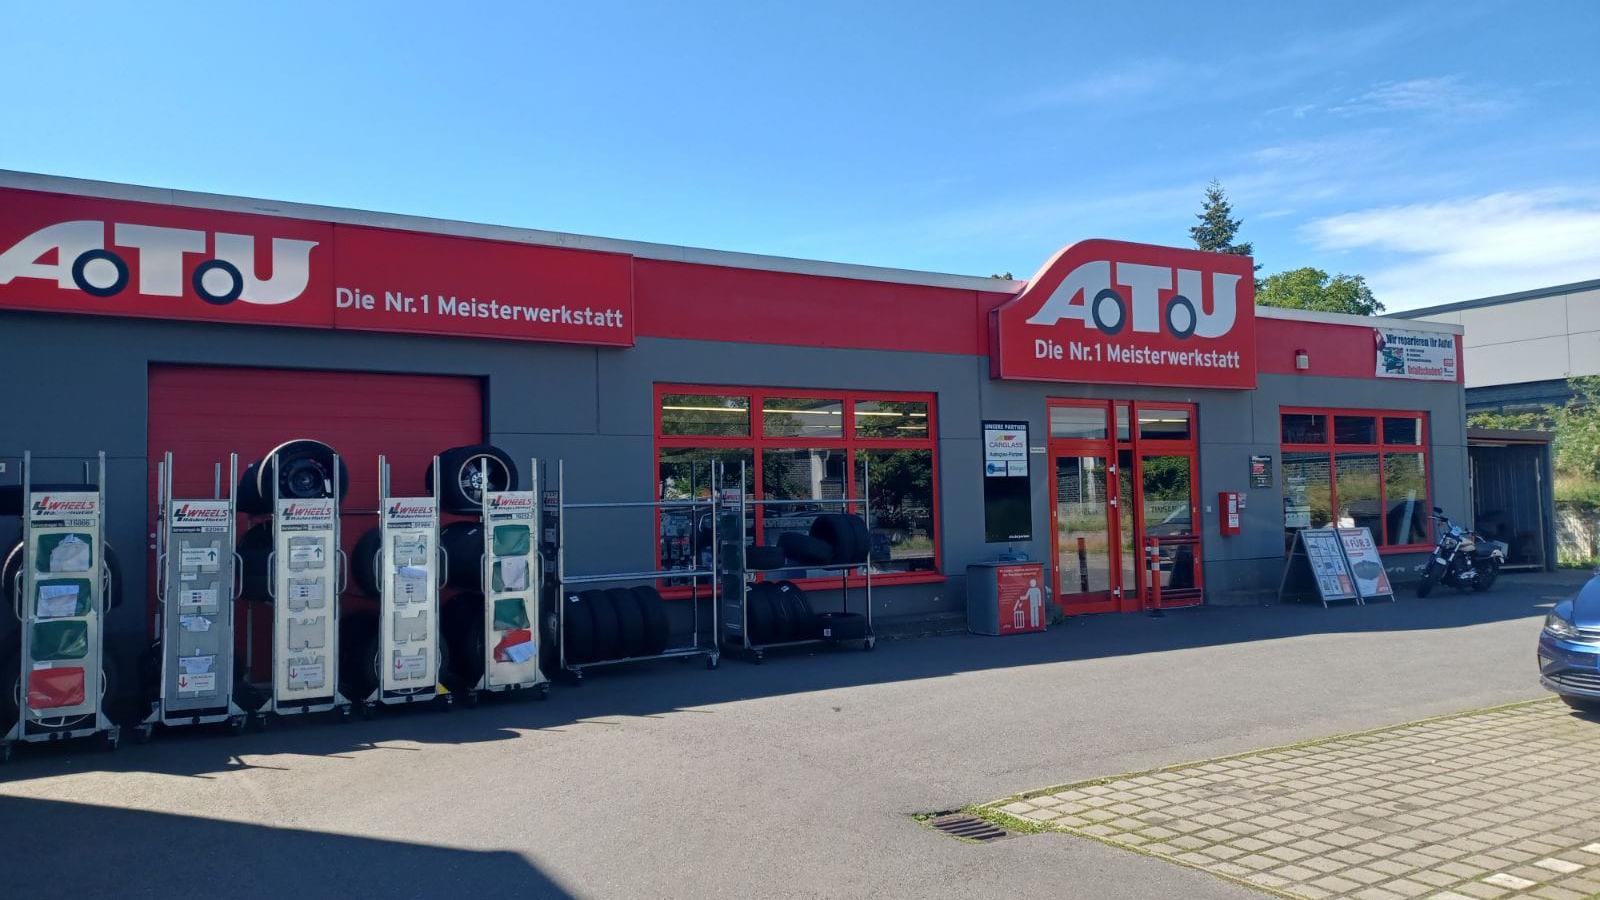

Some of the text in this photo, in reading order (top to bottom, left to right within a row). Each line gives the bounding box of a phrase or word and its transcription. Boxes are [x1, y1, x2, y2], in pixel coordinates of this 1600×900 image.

[0, 220, 320, 305] ATU
[335, 287, 375, 310] Die
[438, 295, 623, 328] Meisterwerkstatt
[1026, 260, 1242, 340] ATU
[1035, 339, 1063, 360] Die
[1107, 343, 1240, 369] Meisterwerkstatt
[1386, 333, 1397, 344] Wir
[1398, 336, 1429, 347] reparieren
